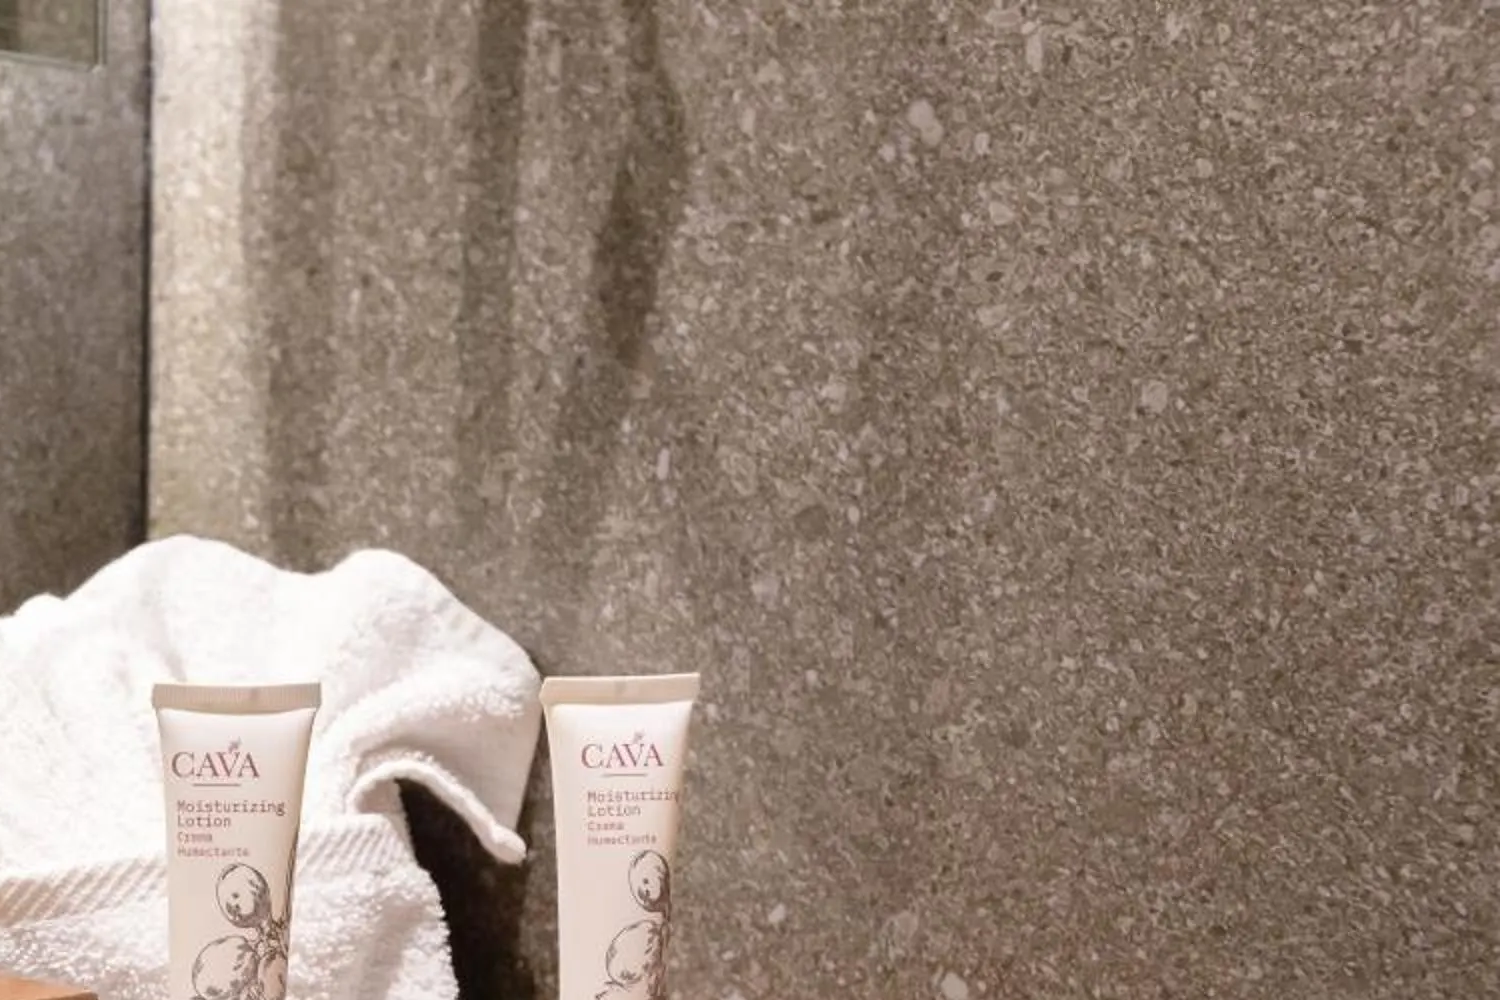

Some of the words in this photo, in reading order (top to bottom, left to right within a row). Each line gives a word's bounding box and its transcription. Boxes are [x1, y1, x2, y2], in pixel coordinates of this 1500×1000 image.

[580, 743, 664, 769] CAVA
[171, 751, 260, 778] CAVA
[177, 800, 286, 816] Moisturizing
[587, 804, 641, 817] Lotion
[177, 815, 231, 828] Lotion
